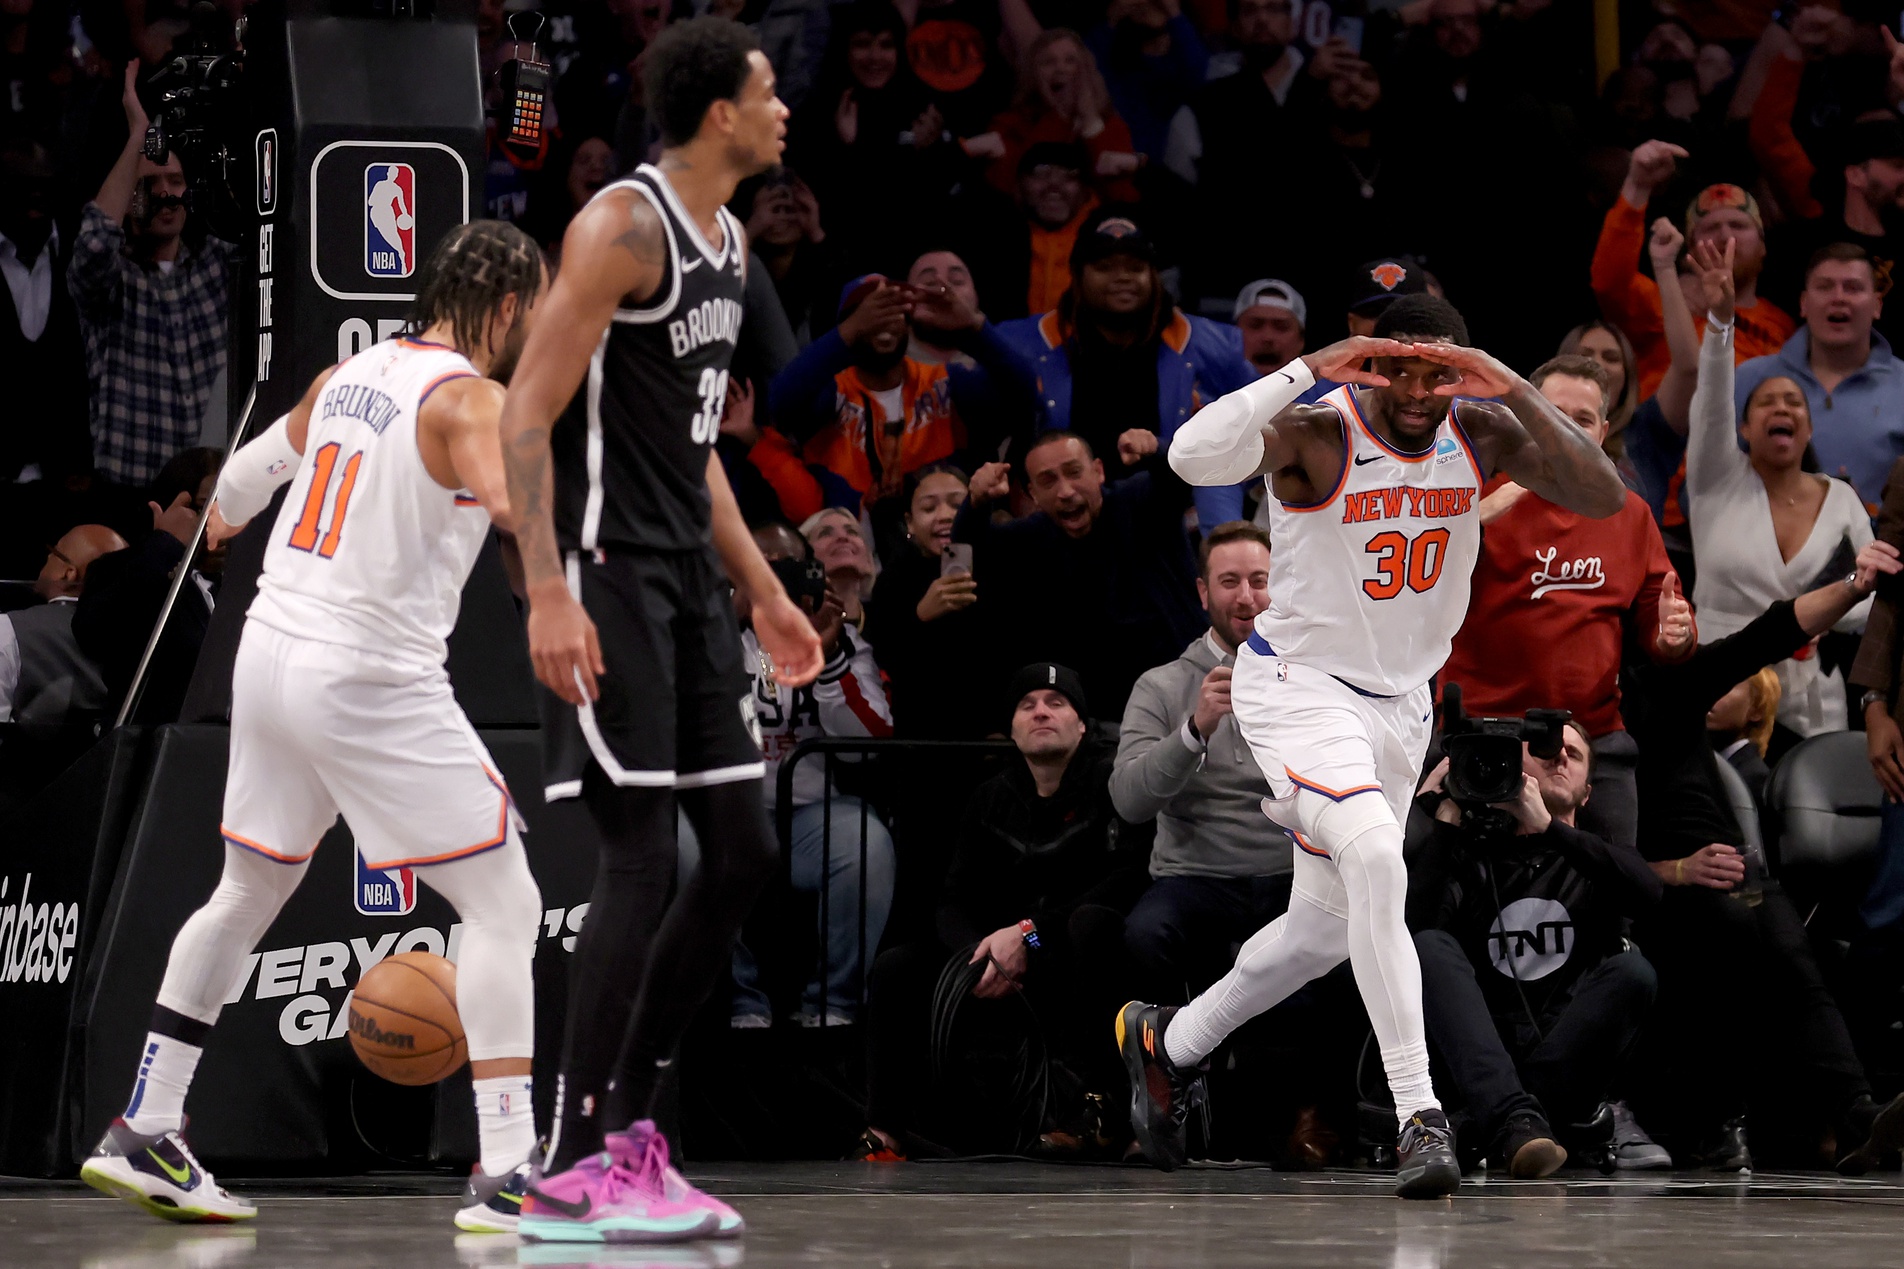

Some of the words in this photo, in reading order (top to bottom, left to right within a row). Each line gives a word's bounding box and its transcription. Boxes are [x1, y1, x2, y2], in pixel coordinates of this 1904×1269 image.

[259, 223, 274, 274] GET
[372, 251, 396, 270] NBA
[258, 277, 273, 328] THE
[257, 332, 273, 382] APP
[321, 384, 401, 436] BRUNSON
[1436, 451, 1464, 465] sphere
[287, 441, 363, 560] 11
[1342, 486, 1406, 525] NEW
[1405, 485, 1477, 519] YORK
[1362, 527, 1451, 601] 30
[1530, 546, 1605, 588] Leon
[750, 672, 820, 727] SA
[363, 883, 393, 906] NBA
[1487, 920, 1574, 961] TNT
[348, 1006, 415, 1050] Wilson
